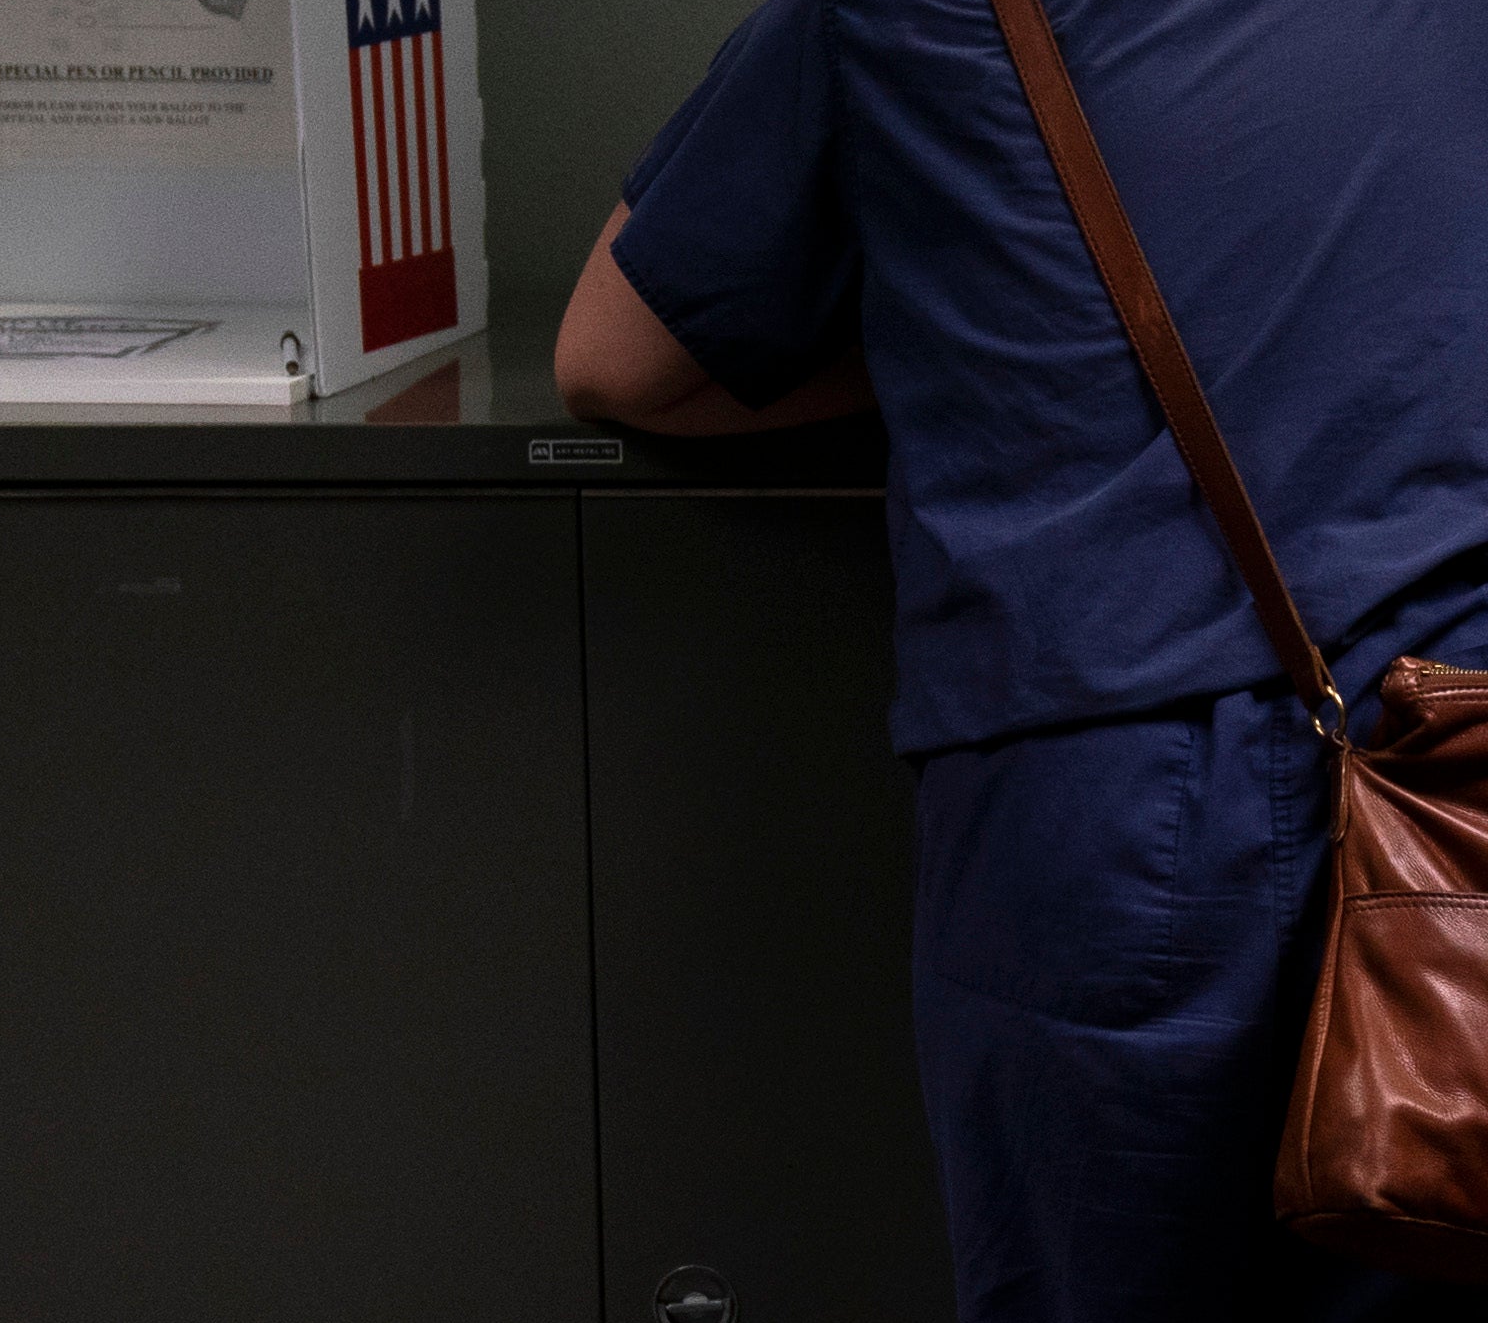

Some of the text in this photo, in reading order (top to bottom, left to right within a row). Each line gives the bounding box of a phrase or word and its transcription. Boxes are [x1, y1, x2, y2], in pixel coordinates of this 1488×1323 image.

[66, 65, 97, 80] PEN
[100, 66, 124, 81] OR
[128, 66, 184, 82] PENCIL
[191, 66, 274, 84] PROVIDED
